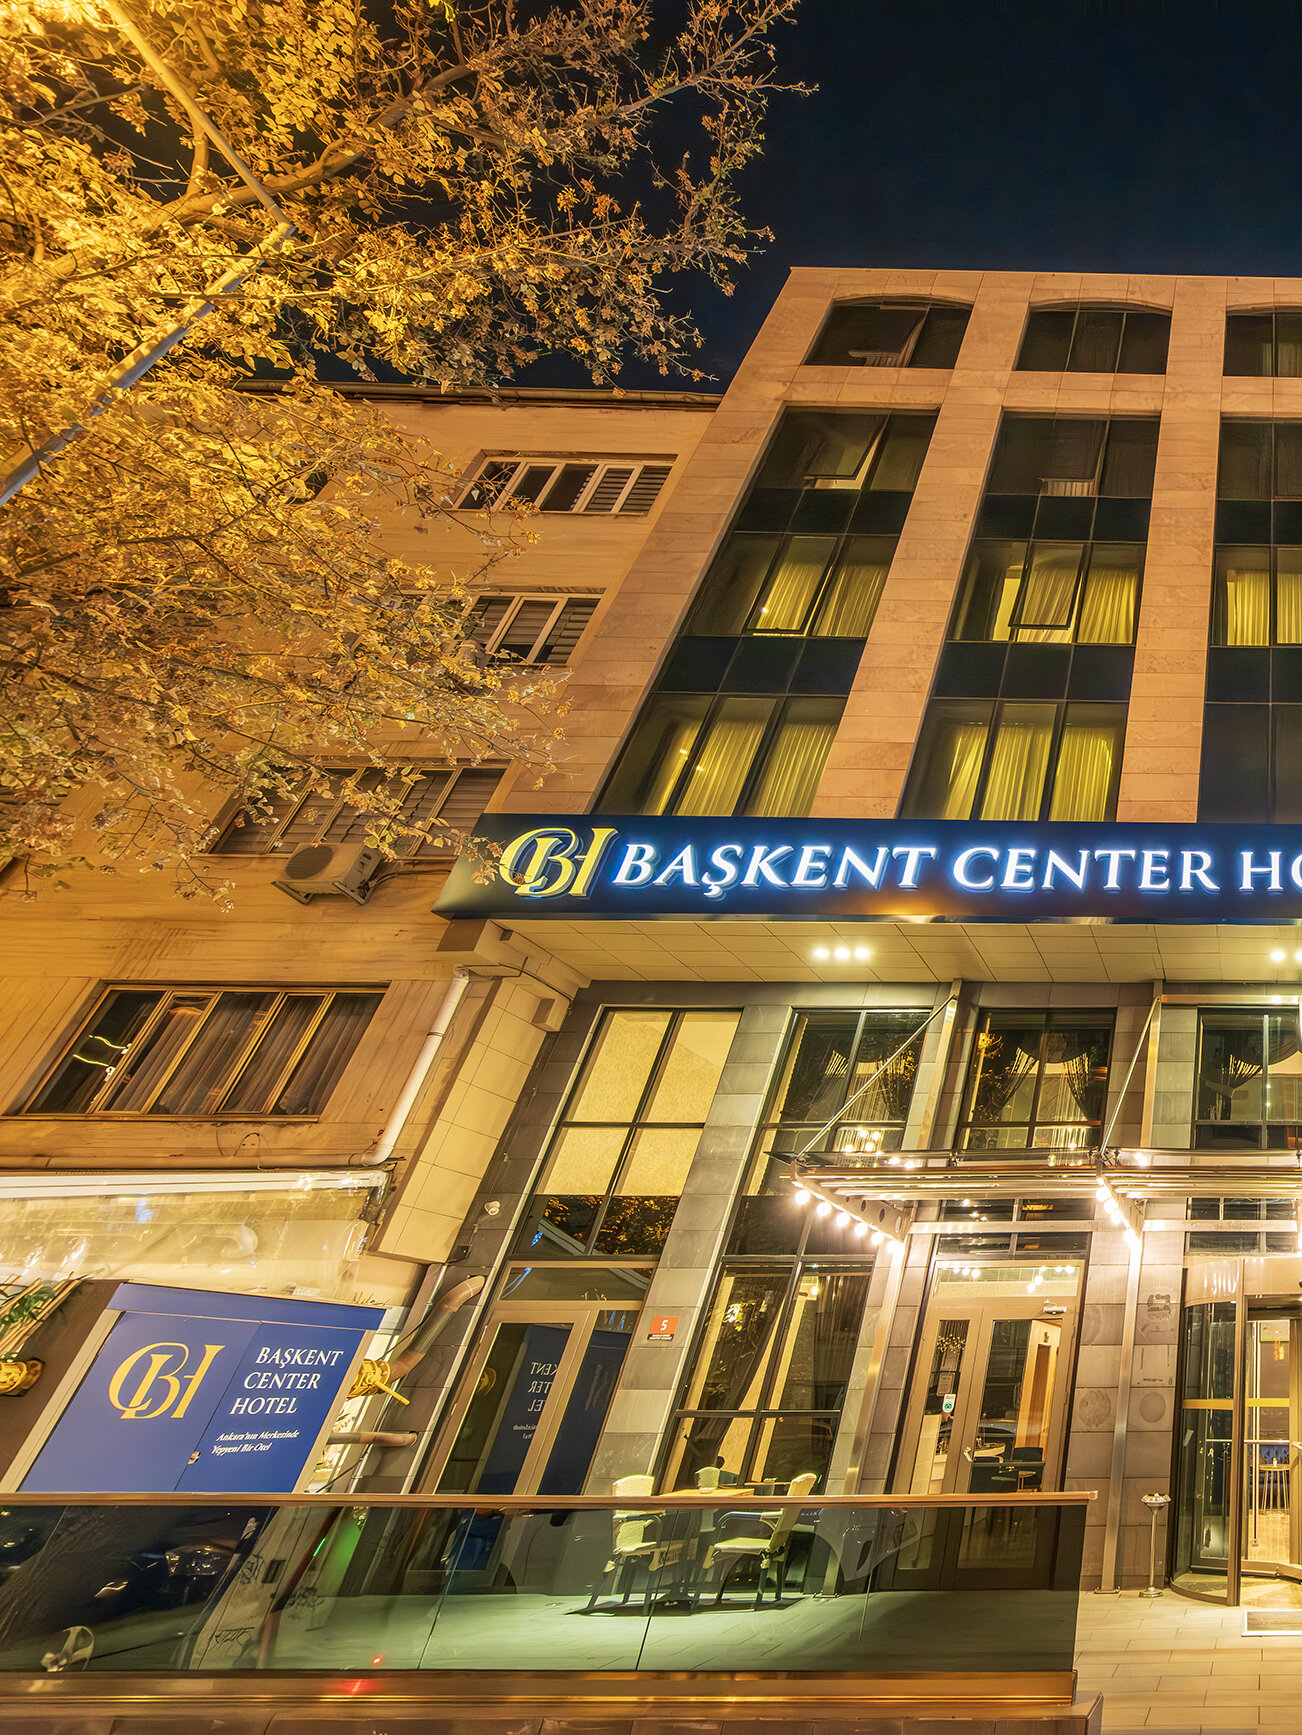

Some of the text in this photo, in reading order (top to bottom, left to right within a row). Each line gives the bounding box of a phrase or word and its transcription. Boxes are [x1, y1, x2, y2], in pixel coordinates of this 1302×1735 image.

[612, 843, 937, 899] BAŞKENT
[952, 846, 1220, 894] CENTER
[660, 1319, 669, 1331] 5
[255, 1346, 344, 1368] BAŞKENT
[243, 1371, 321, 1389] CENTER
[230, 1397, 298, 1415] HOTEL
[254, 1441, 273, 1452] Otel
